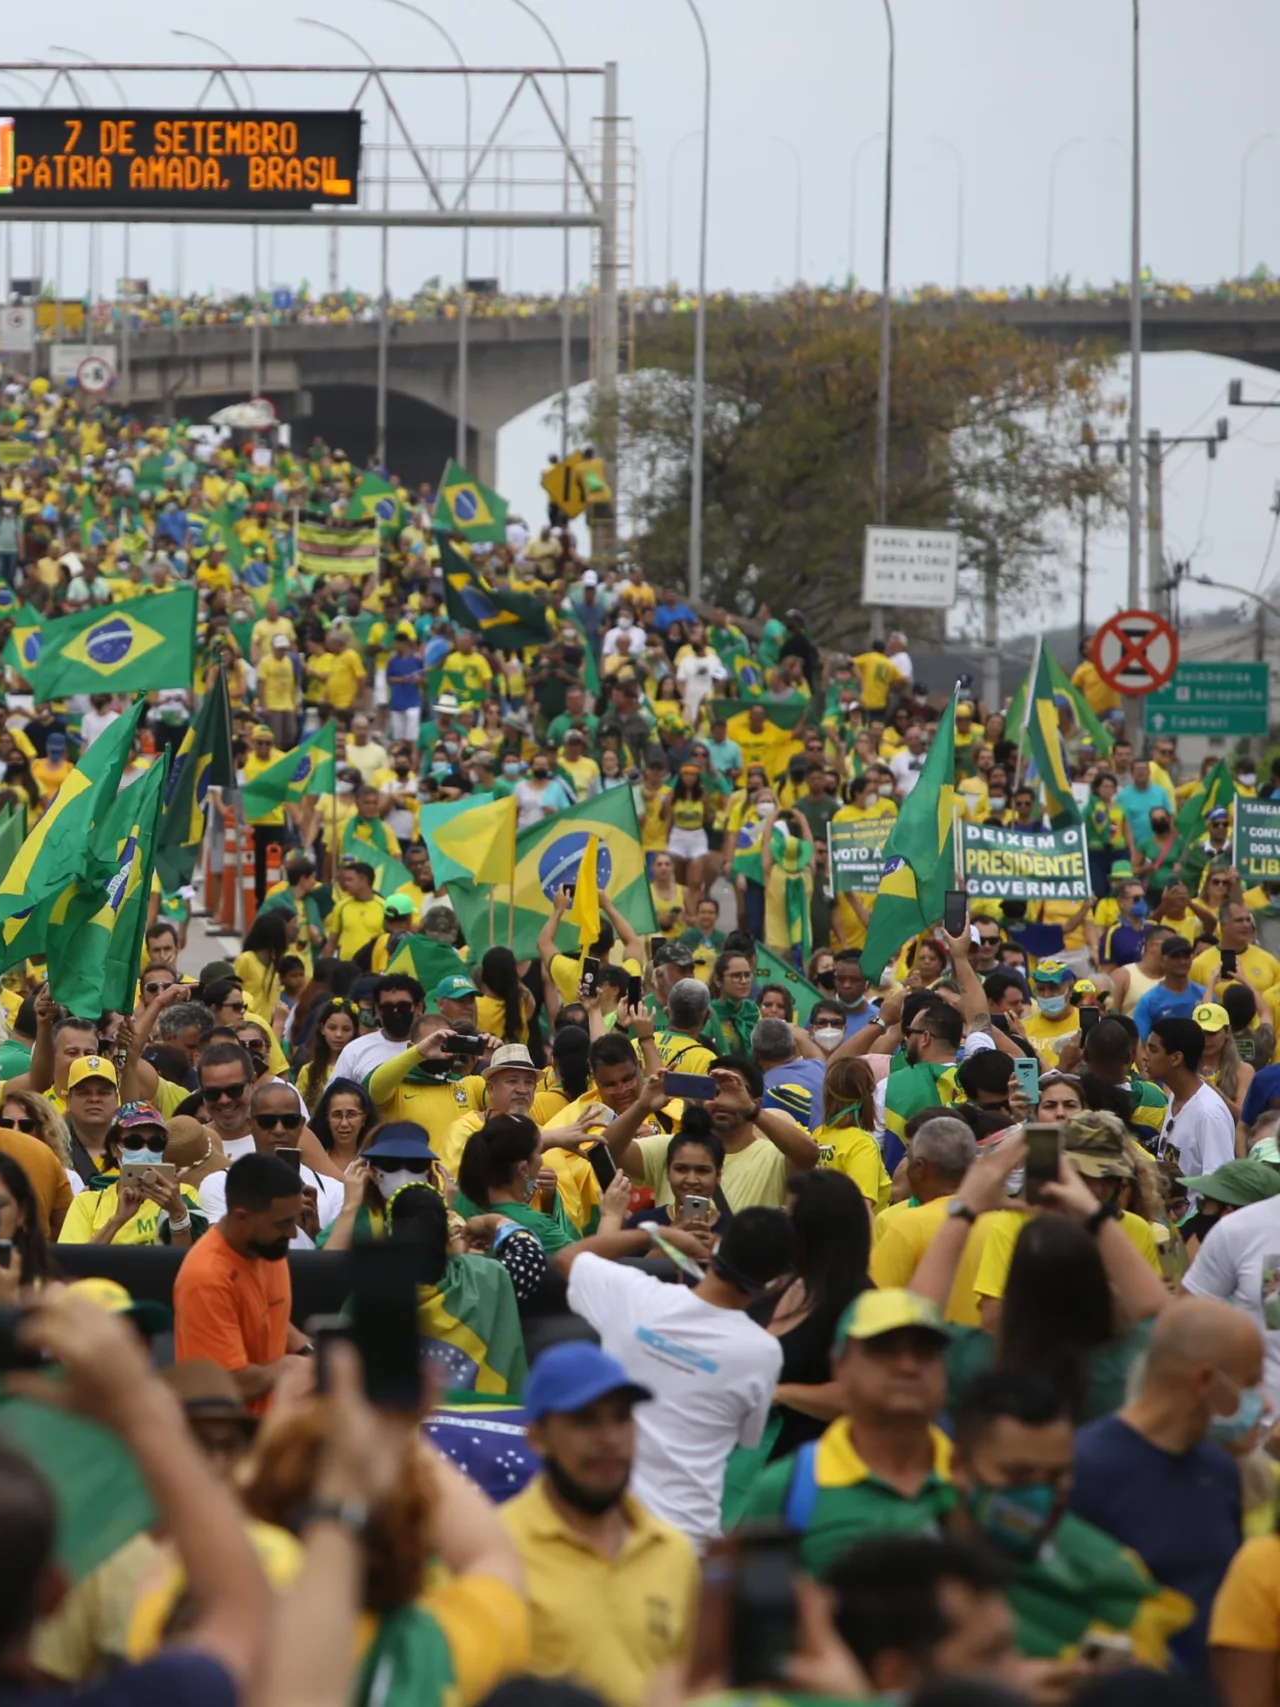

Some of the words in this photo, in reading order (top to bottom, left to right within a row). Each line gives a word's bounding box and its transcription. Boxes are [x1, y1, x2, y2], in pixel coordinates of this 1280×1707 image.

[64, 120, 83, 153] 7
[99, 120, 136, 155] DE
[154, 121, 298, 156] SETEMBRO
[129, 156, 231, 190] AMADA,
[248, 156, 351, 196] BRASIL
[966, 825, 1055, 848] DEIXEM
[1063, 830, 1078, 844] O
[832, 847, 869, 860] VOTO
[873, 846, 882, 859] A
[1250, 843, 1272, 855] DOS
[965, 849, 1084, 876] PRESIDENTE
[966, 879, 1086, 896] GOVERNAR
